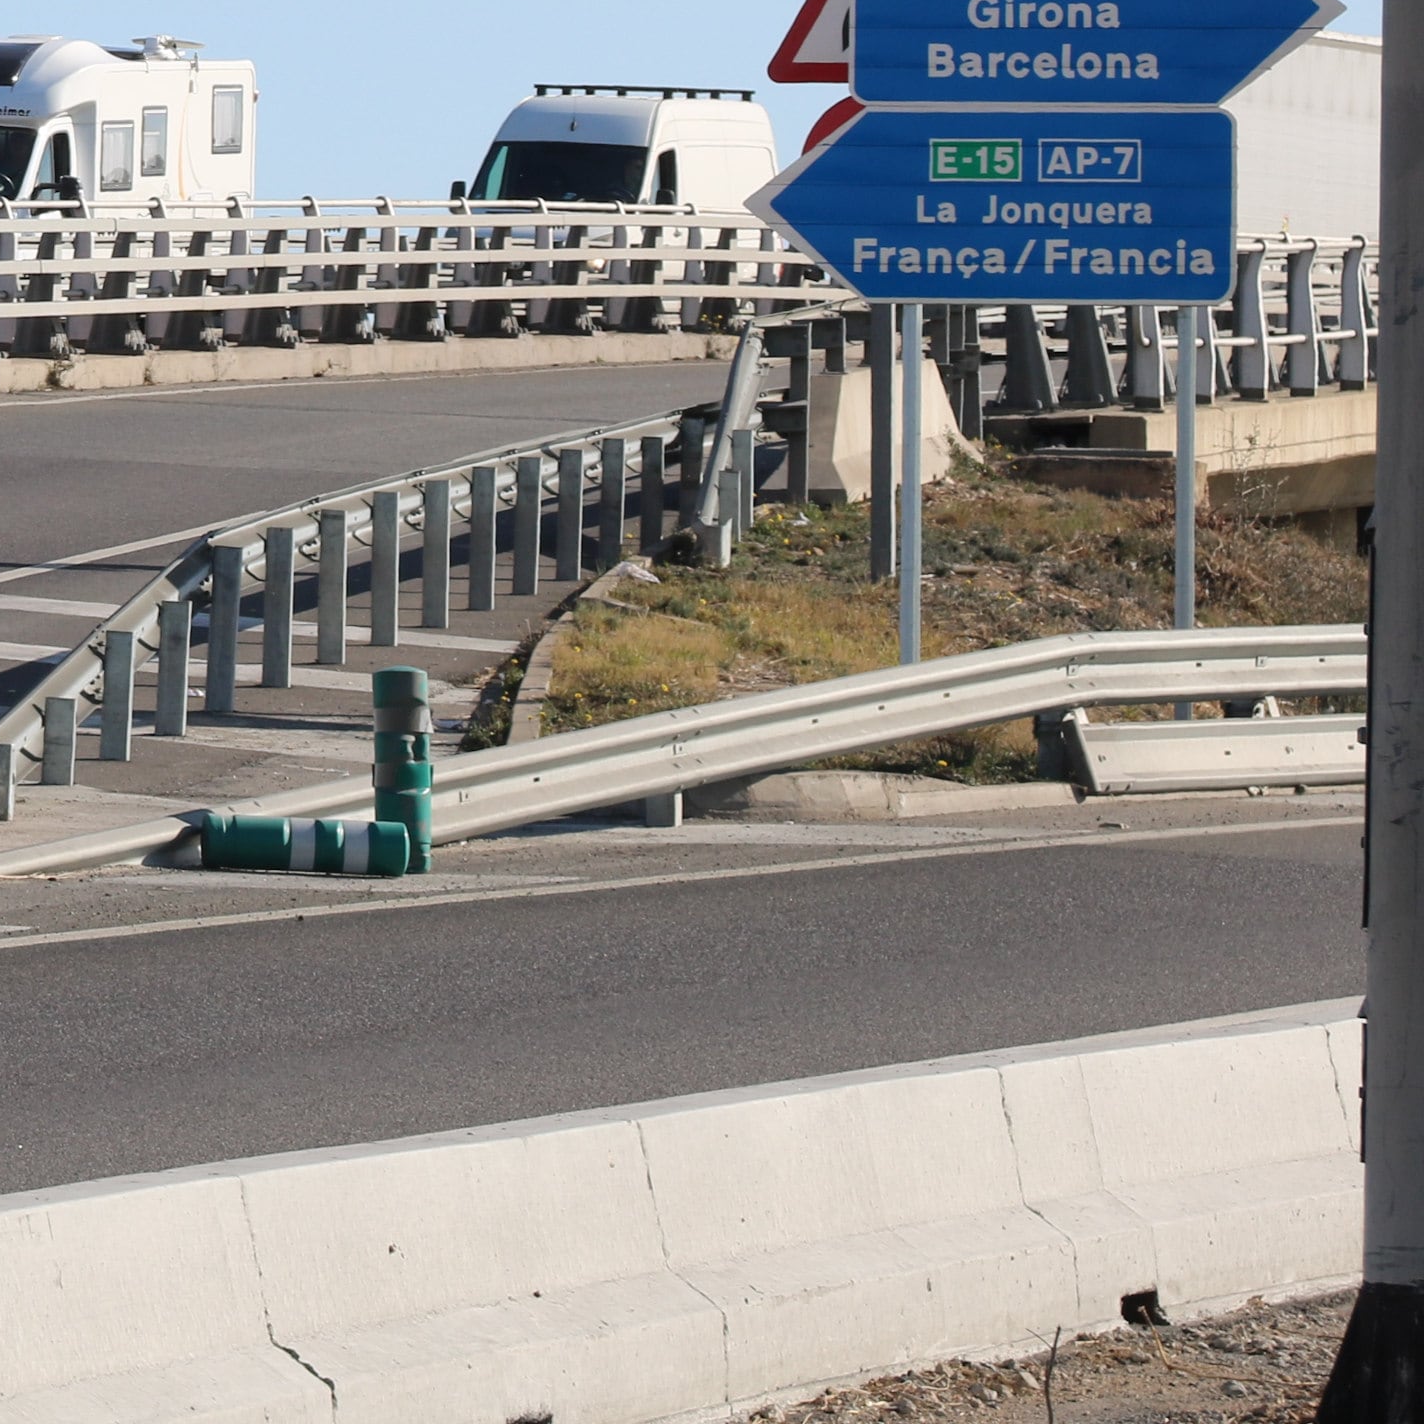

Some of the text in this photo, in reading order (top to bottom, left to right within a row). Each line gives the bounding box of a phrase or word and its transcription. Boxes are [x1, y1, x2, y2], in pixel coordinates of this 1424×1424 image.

[927, 43, 1160, 80] Barcelona
[936, 146, 1135, 175] E-15 AP-7
[916, 195, 1153, 229] La Jonquera
